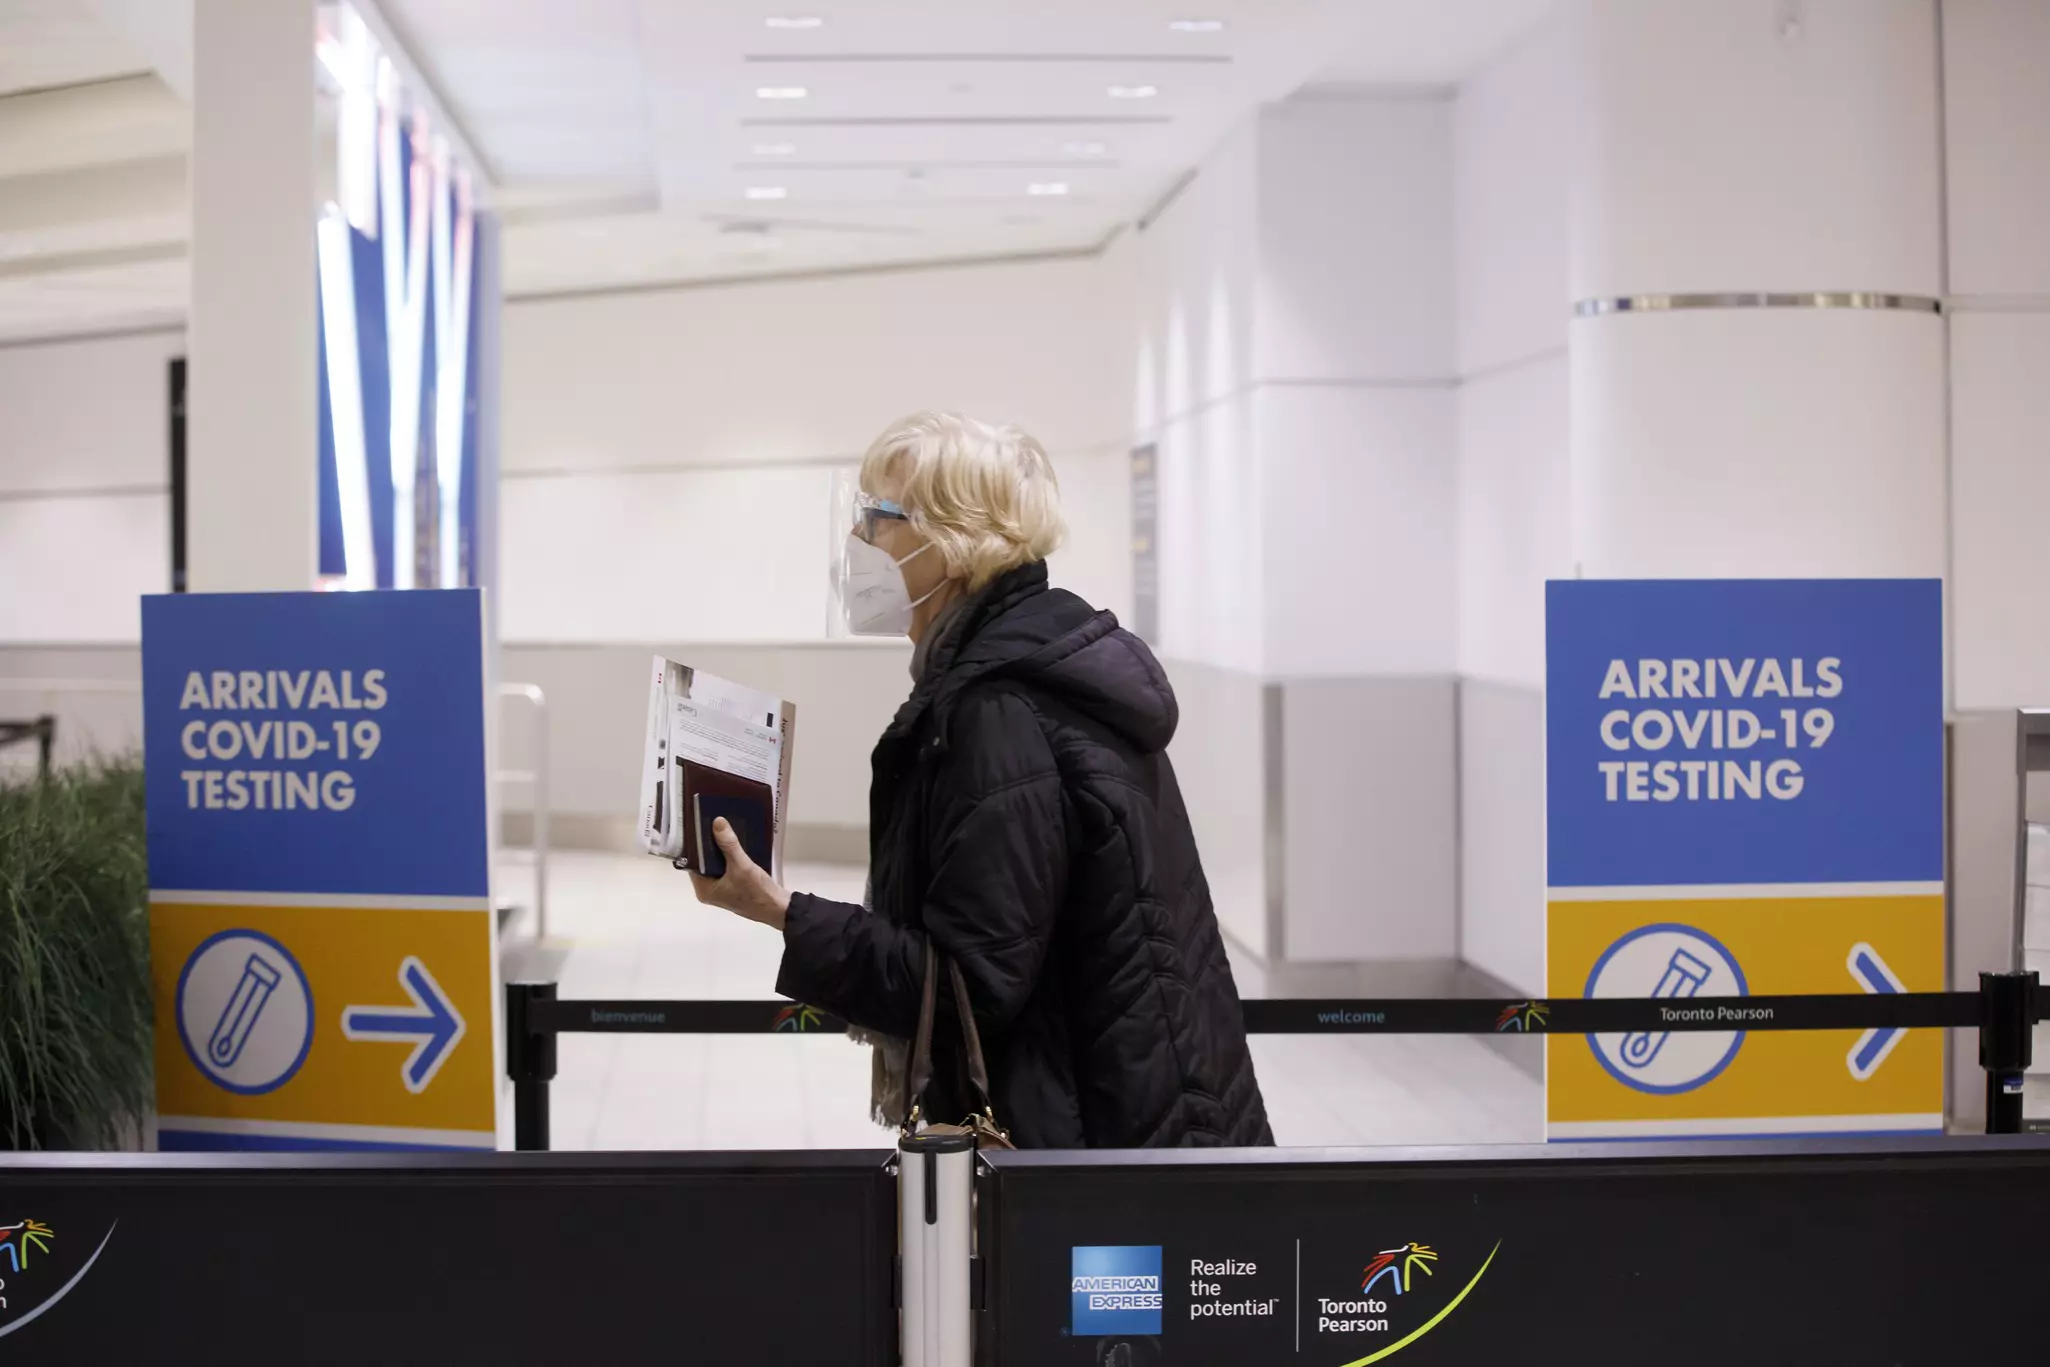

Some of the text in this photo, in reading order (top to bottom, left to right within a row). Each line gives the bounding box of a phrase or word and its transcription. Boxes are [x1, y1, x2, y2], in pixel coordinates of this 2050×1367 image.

[1598, 657, 1843, 699] ARRIVALS
[180, 669, 388, 711] ARRIVALS
[1600, 707, 1835, 751] COVID-19
[181, 720, 382, 761] COVID-19
[1598, 759, 1805, 802] TESTING
[181, 770, 356, 811] TESTING
[591, 1009, 666, 1024] bienvenue
[1317, 1009, 1386, 1024] welcome
[1660, 1006, 1775, 1022] Toronto Pearson
[1190, 1258, 1257, 1277] Realize
[1072, 1275, 1159, 1293] AMERICAN
[1190, 1280, 1221, 1296] the
[1089, 1293, 1163, 1310] EXPRESS
[1317, 1298, 1388, 1315] Toronto
[1318, 1316, 1389, 1334] Pearson
